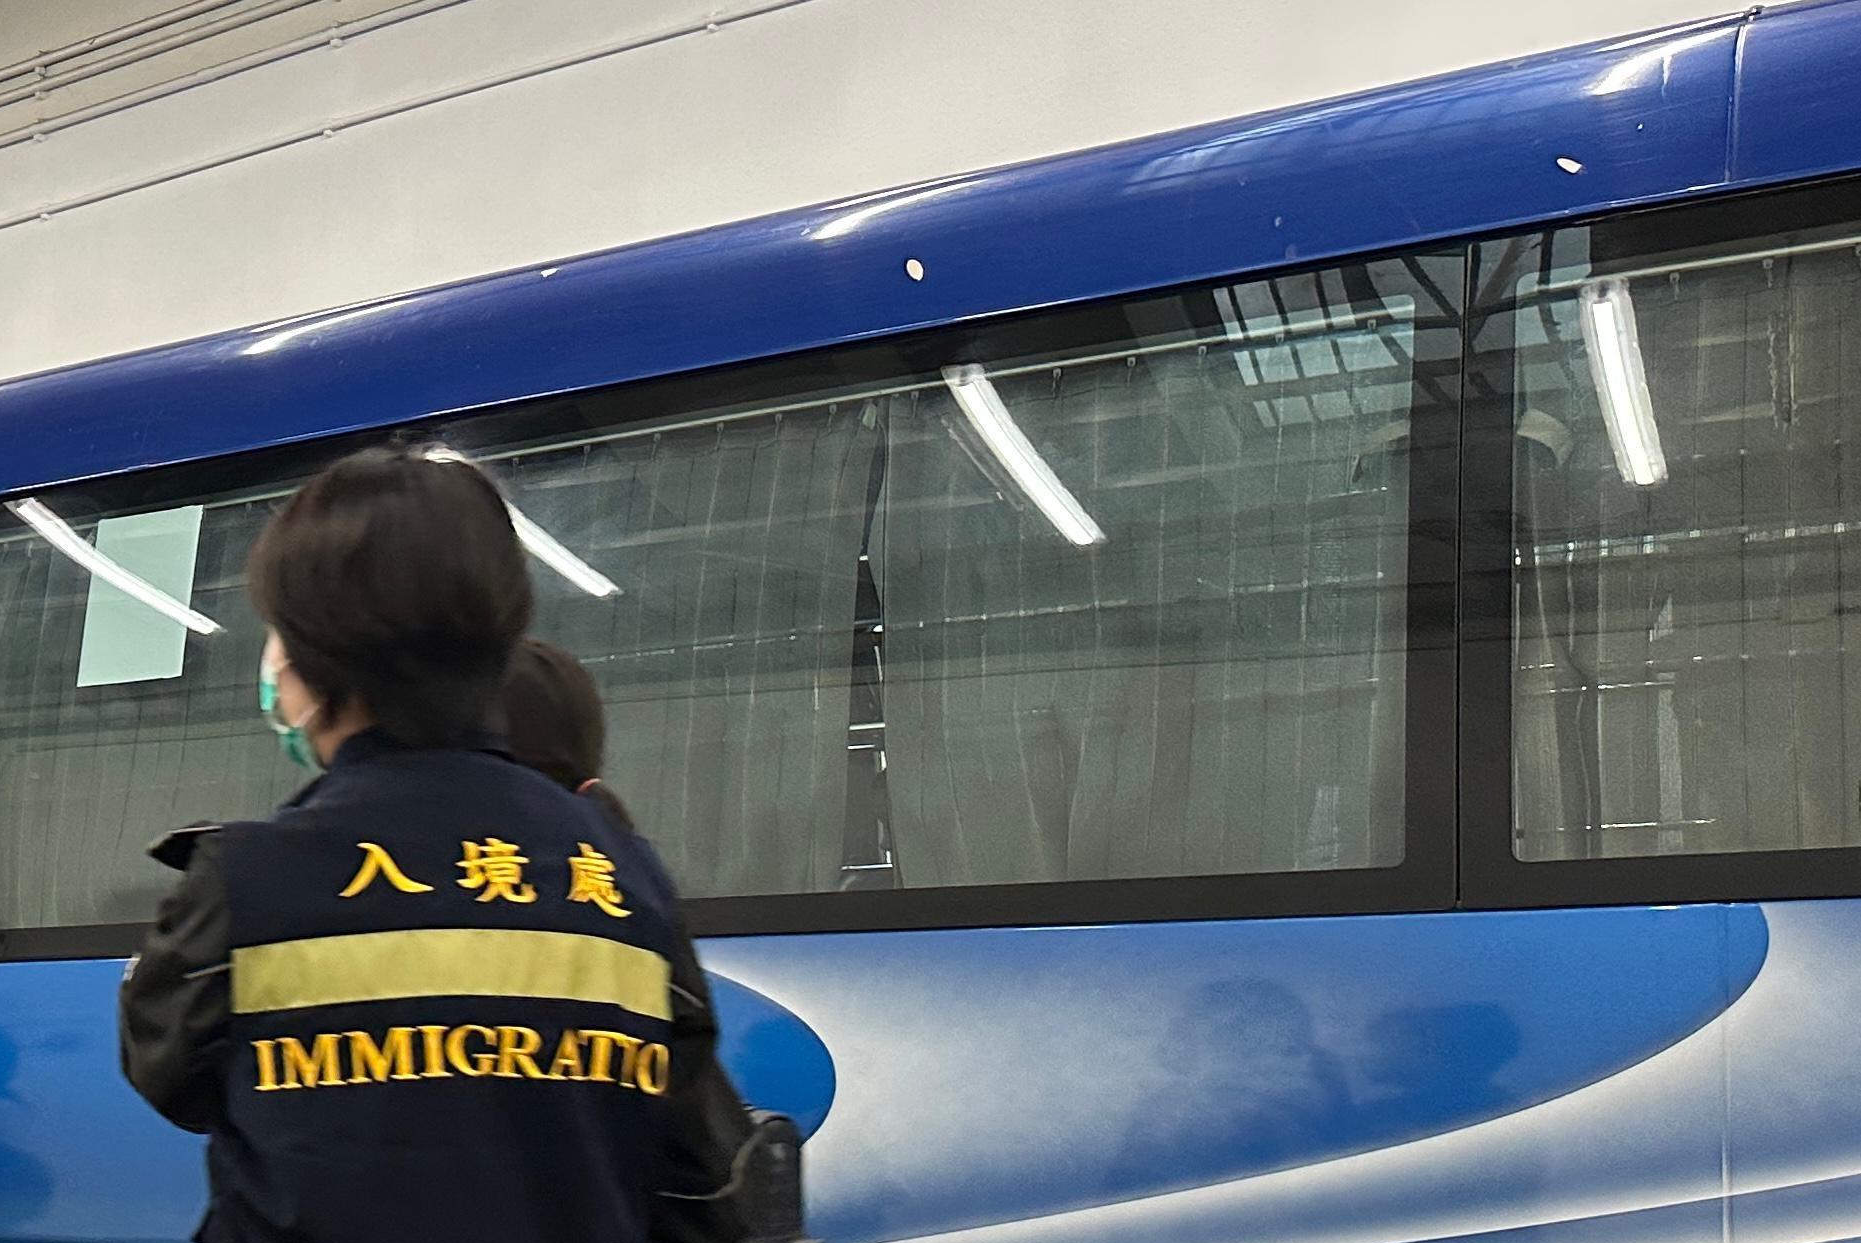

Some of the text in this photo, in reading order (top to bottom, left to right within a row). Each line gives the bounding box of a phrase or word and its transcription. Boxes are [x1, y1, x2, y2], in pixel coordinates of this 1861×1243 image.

[339, 838, 631, 917] 入境處
[251, 1025, 669, 1096] IMMIGRATIO
